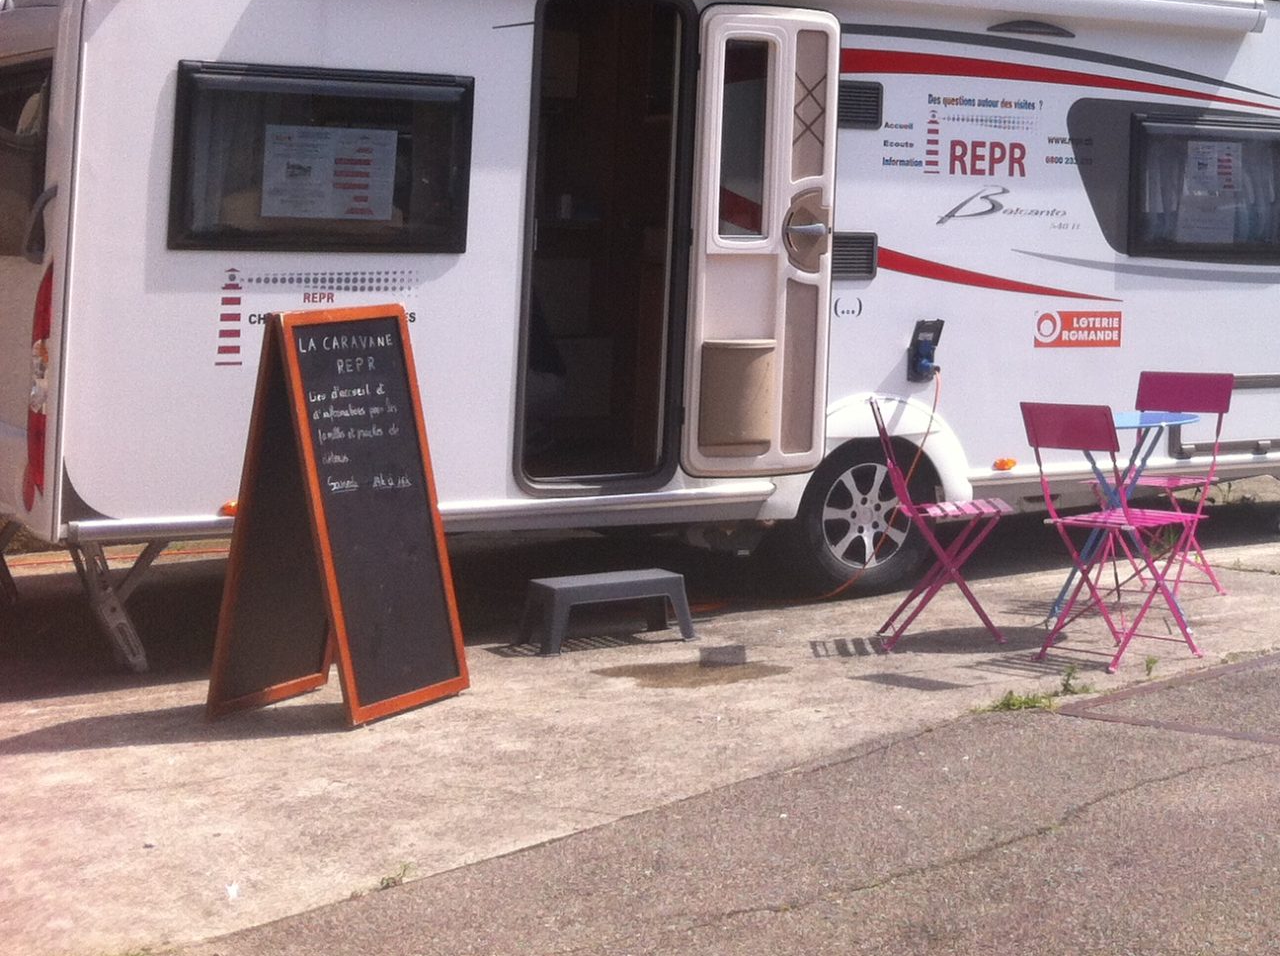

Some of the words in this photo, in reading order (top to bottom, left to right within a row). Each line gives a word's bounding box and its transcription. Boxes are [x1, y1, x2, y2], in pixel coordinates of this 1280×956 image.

[928, 94, 941, 105] Des
[942, 96, 976, 109] questions
[977, 97, 999, 108] autour
[1000, 99, 1013, 109] des
[1014, 99, 1036, 111] visites
[1039, 100, 1043, 110] ?
[884, 121, 914, 130] Accueil
[883, 139, 915, 148] Ecoute
[882, 156, 923, 167] Information
[949, 139, 1027, 177] REPR
[303, 292, 334, 303] REPR
[1073, 317, 1119, 328] LOTERIE
[1062, 330, 1119, 341] ROMANDE
[298, 337, 317, 353] LA
[322, 333, 393, 351] CARAVANE
[337, 356, 376, 374] REPR
